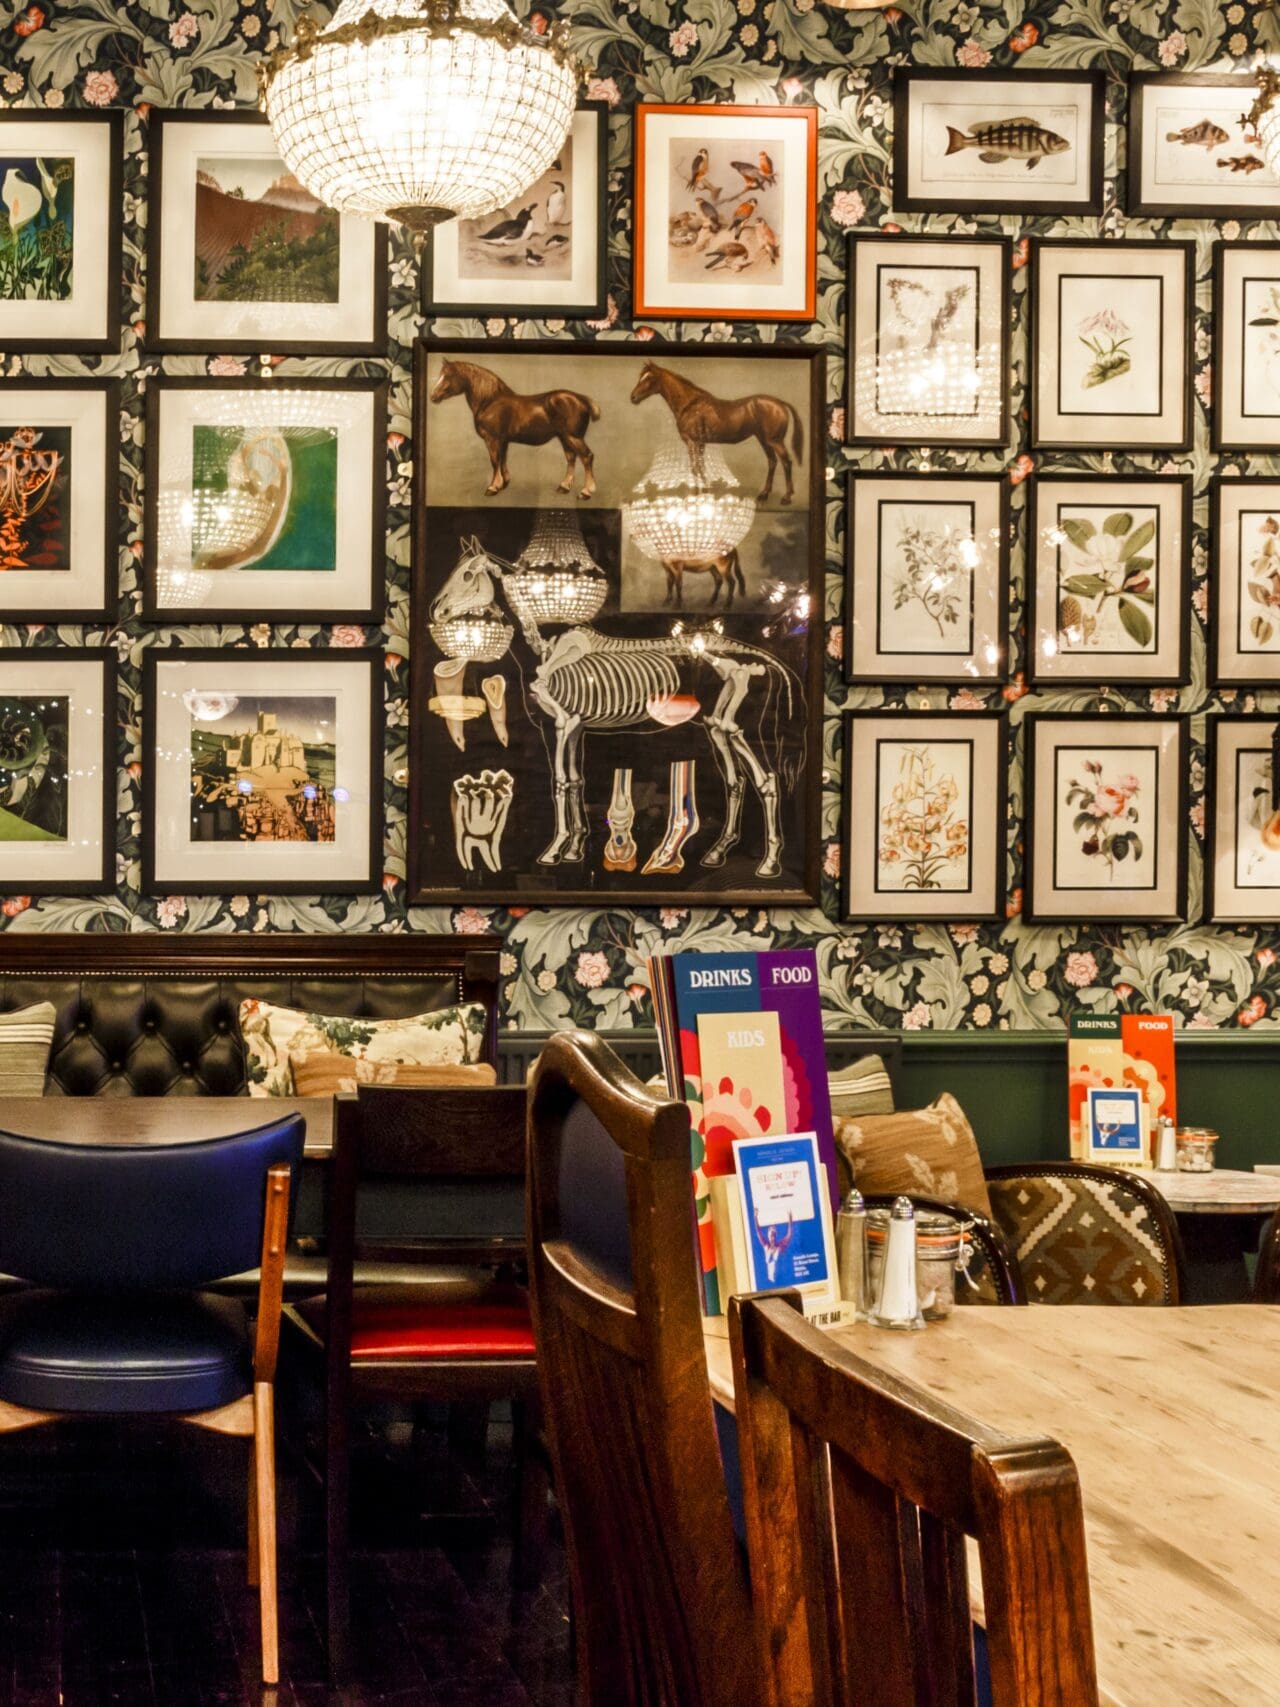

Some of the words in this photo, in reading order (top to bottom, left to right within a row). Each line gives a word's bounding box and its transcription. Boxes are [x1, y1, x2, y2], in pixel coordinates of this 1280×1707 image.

[690, 968, 752, 988] DRINKS
[772, 966, 812, 984] FOOD
[1077, 1020, 1117, 1029] DRINKS
[1138, 1021, 1168, 1030] FOOD
[726, 1030, 766, 1048] KIDS
